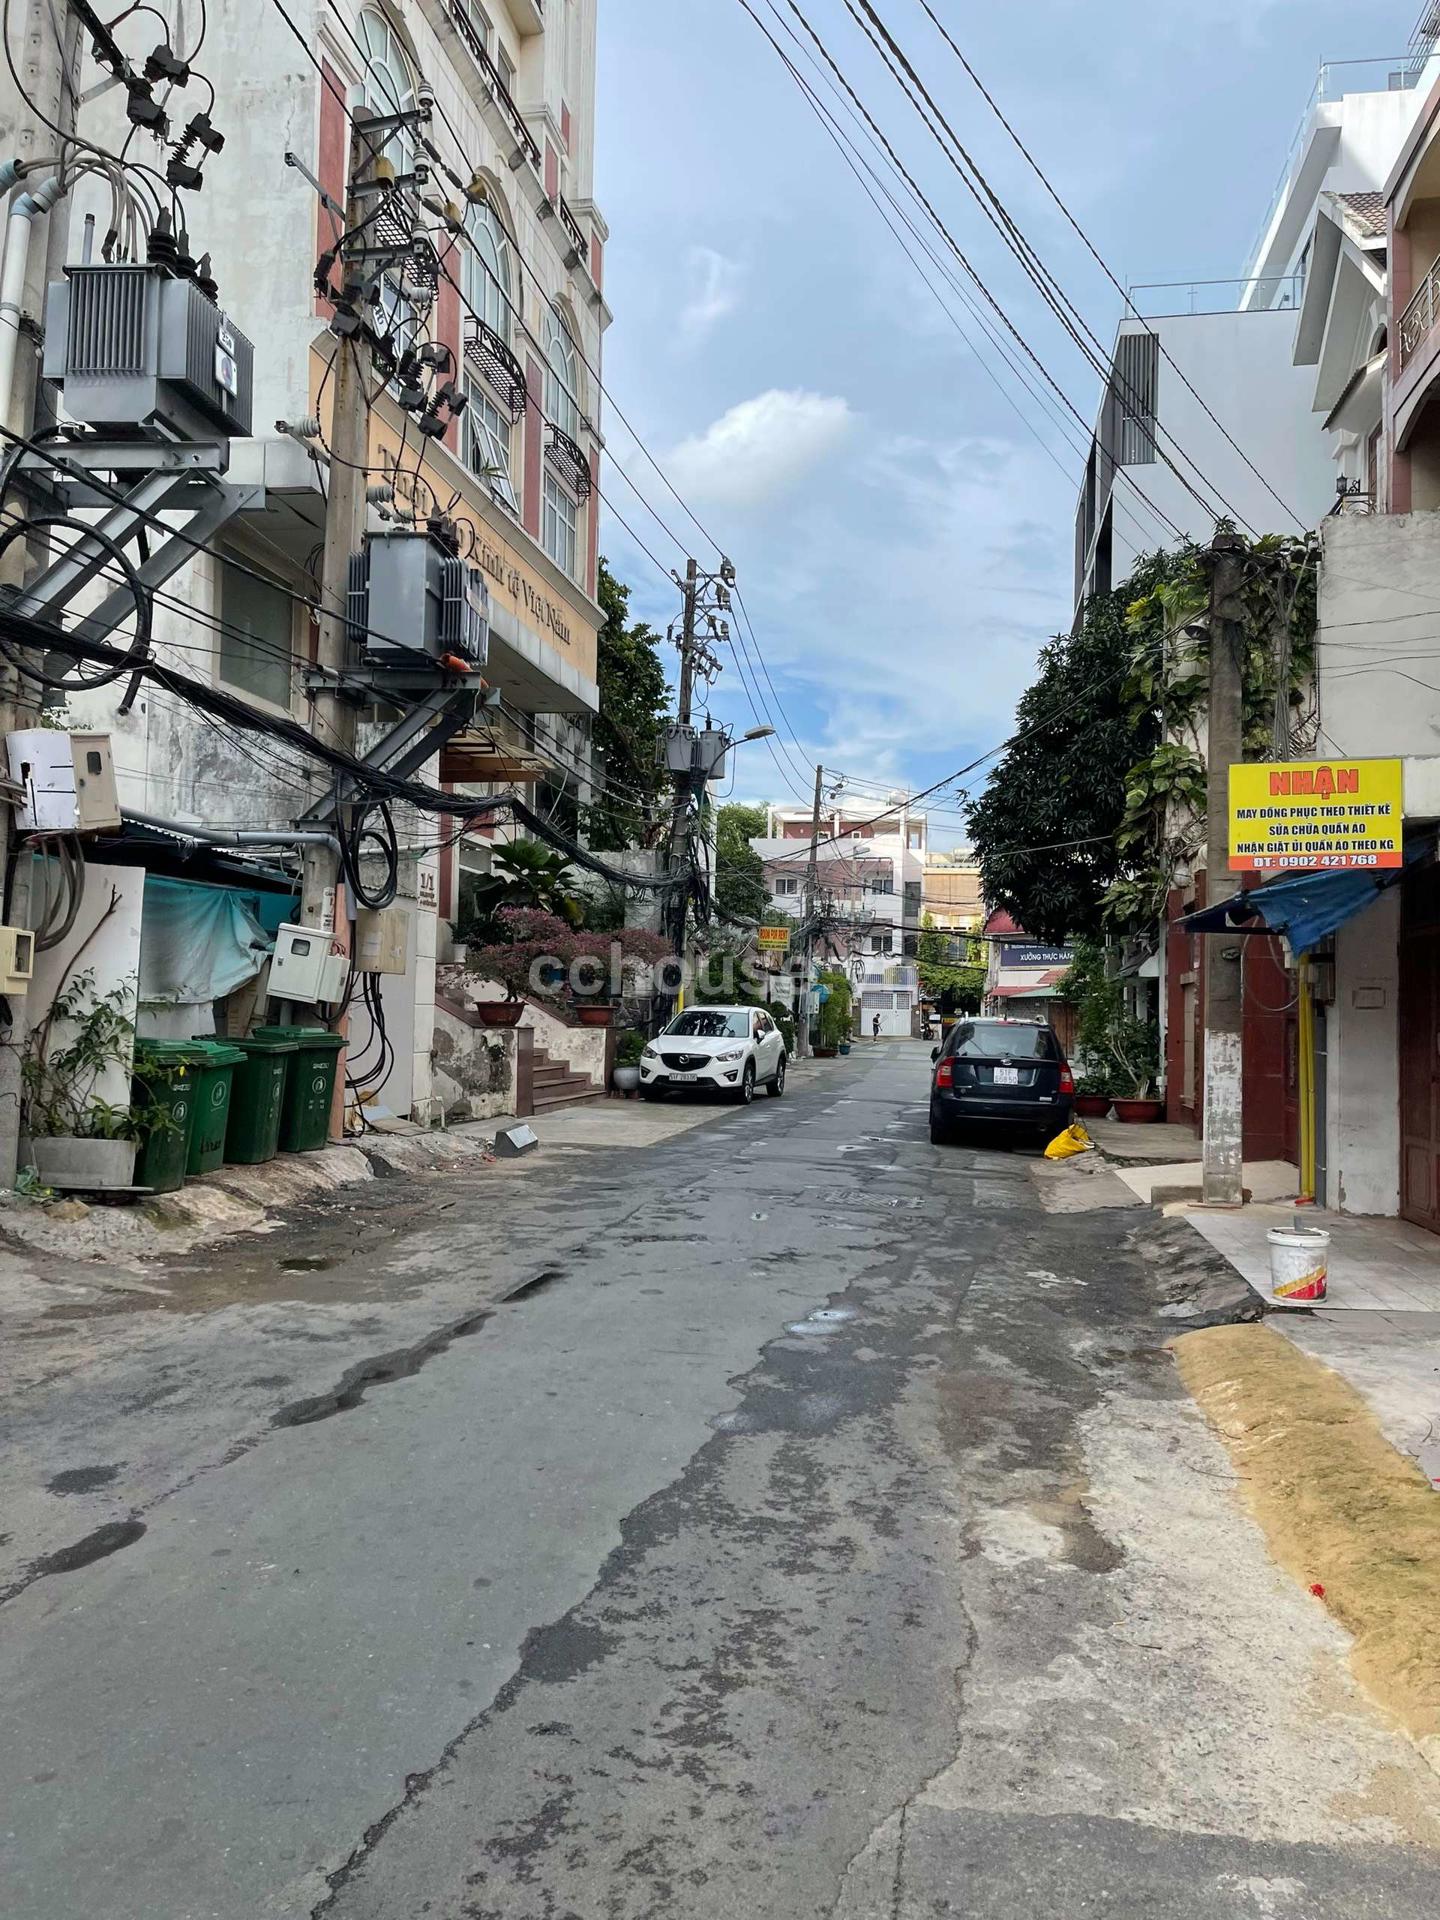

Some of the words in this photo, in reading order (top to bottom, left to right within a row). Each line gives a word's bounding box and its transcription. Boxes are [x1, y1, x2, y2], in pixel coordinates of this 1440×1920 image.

[1269, 765, 1359, 800] NHẬN
[1237, 809, 1257, 819] MAY
[1290, 807, 1317, 819] PHỤC
[1320, 806, 1345, 816] THEO
[1348, 803, 1375, 815] THIẾT
[1292, 822, 1319, 835] CHỮA
[1352, 822, 1366, 834] ÁO
[1237, 842, 1264, 854] NHẬN
[1267, 841, 1289, 854] GIẶT
[1292, 839, 1302, 852] ỦI
[1335, 839, 1349, 851] ÁO
[1352, 840, 1377, 850] THEO
[1380, 840, 1394, 850] KG
[1279, 856, 1317, 867] 0902
[1321, 855, 1346, 866] 421
[1350, 854, 1377, 865] 768
[760, 928, 770, 939] ROOM
[779, 929, 788, 940] RENT
